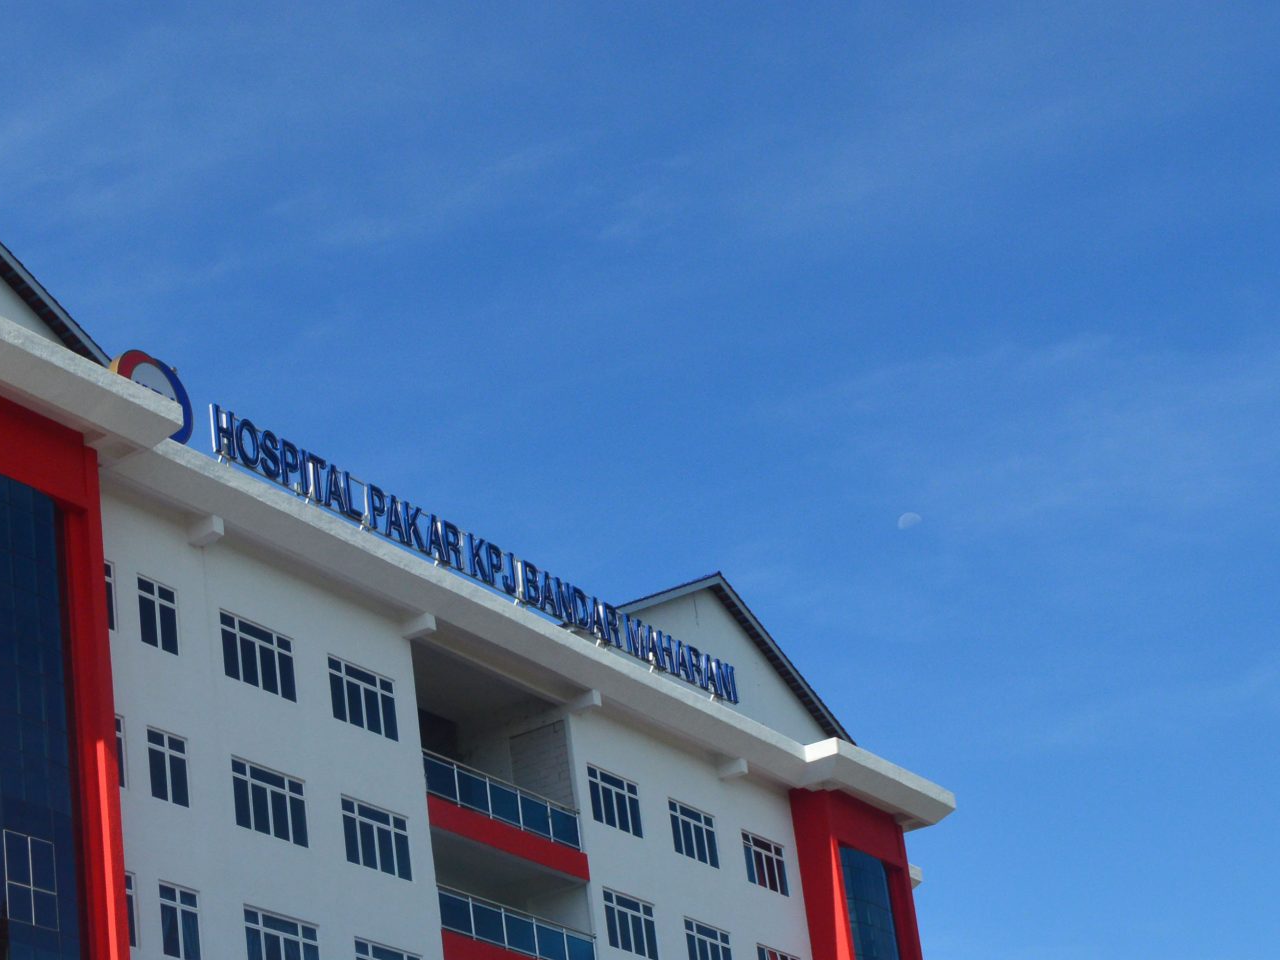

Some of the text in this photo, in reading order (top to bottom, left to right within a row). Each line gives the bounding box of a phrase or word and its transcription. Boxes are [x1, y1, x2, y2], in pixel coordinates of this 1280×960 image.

[209, 403, 739, 705] HOSPITAL PAKAR KPJ BANDAR MAHARANI
